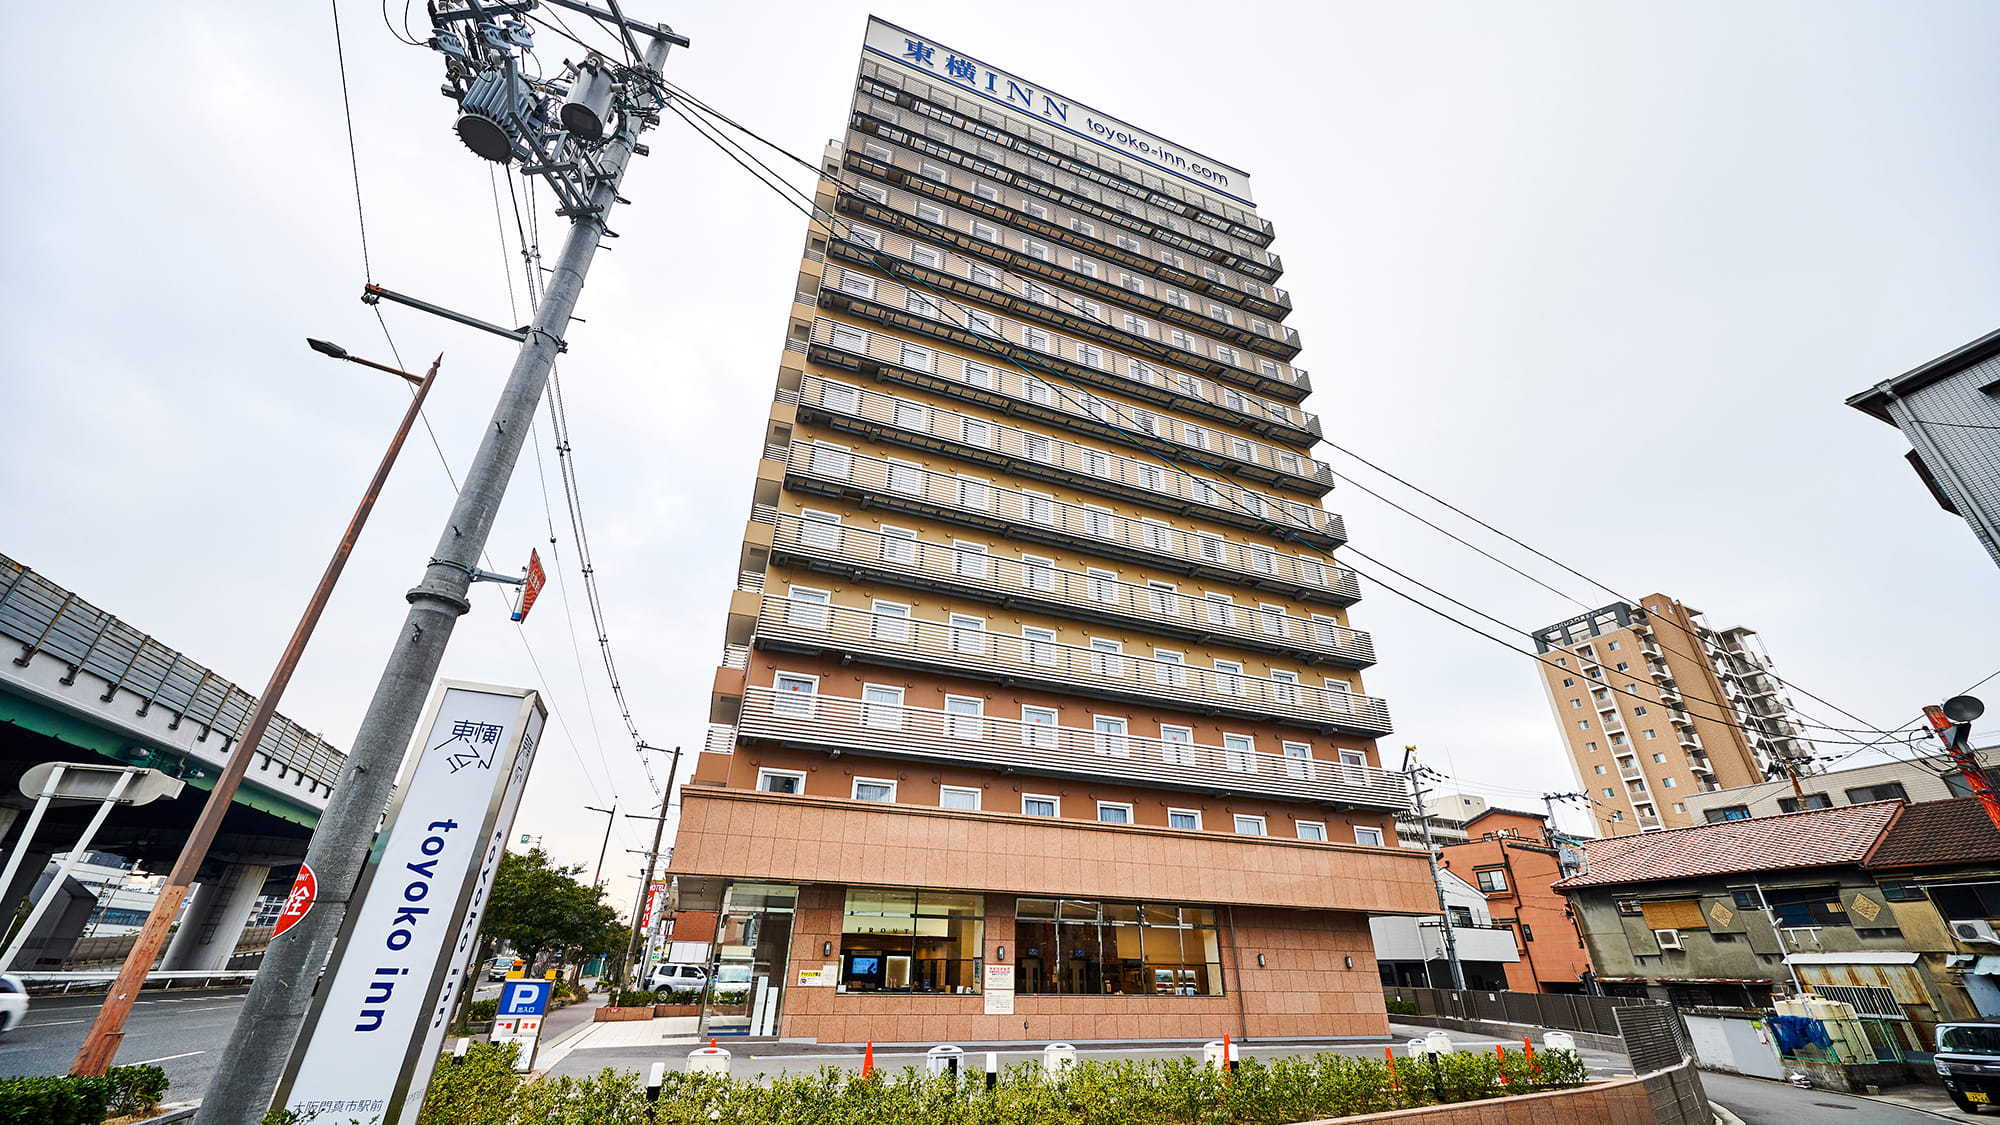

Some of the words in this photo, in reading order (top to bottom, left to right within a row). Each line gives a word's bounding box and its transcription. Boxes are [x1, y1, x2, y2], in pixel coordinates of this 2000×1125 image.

[1087, 118, 1229, 187] toyoko-inn.com
[386, 819, 458, 951] toyoko
[355, 967, 409, 1032] inn
[508, 984, 540, 1013] P
